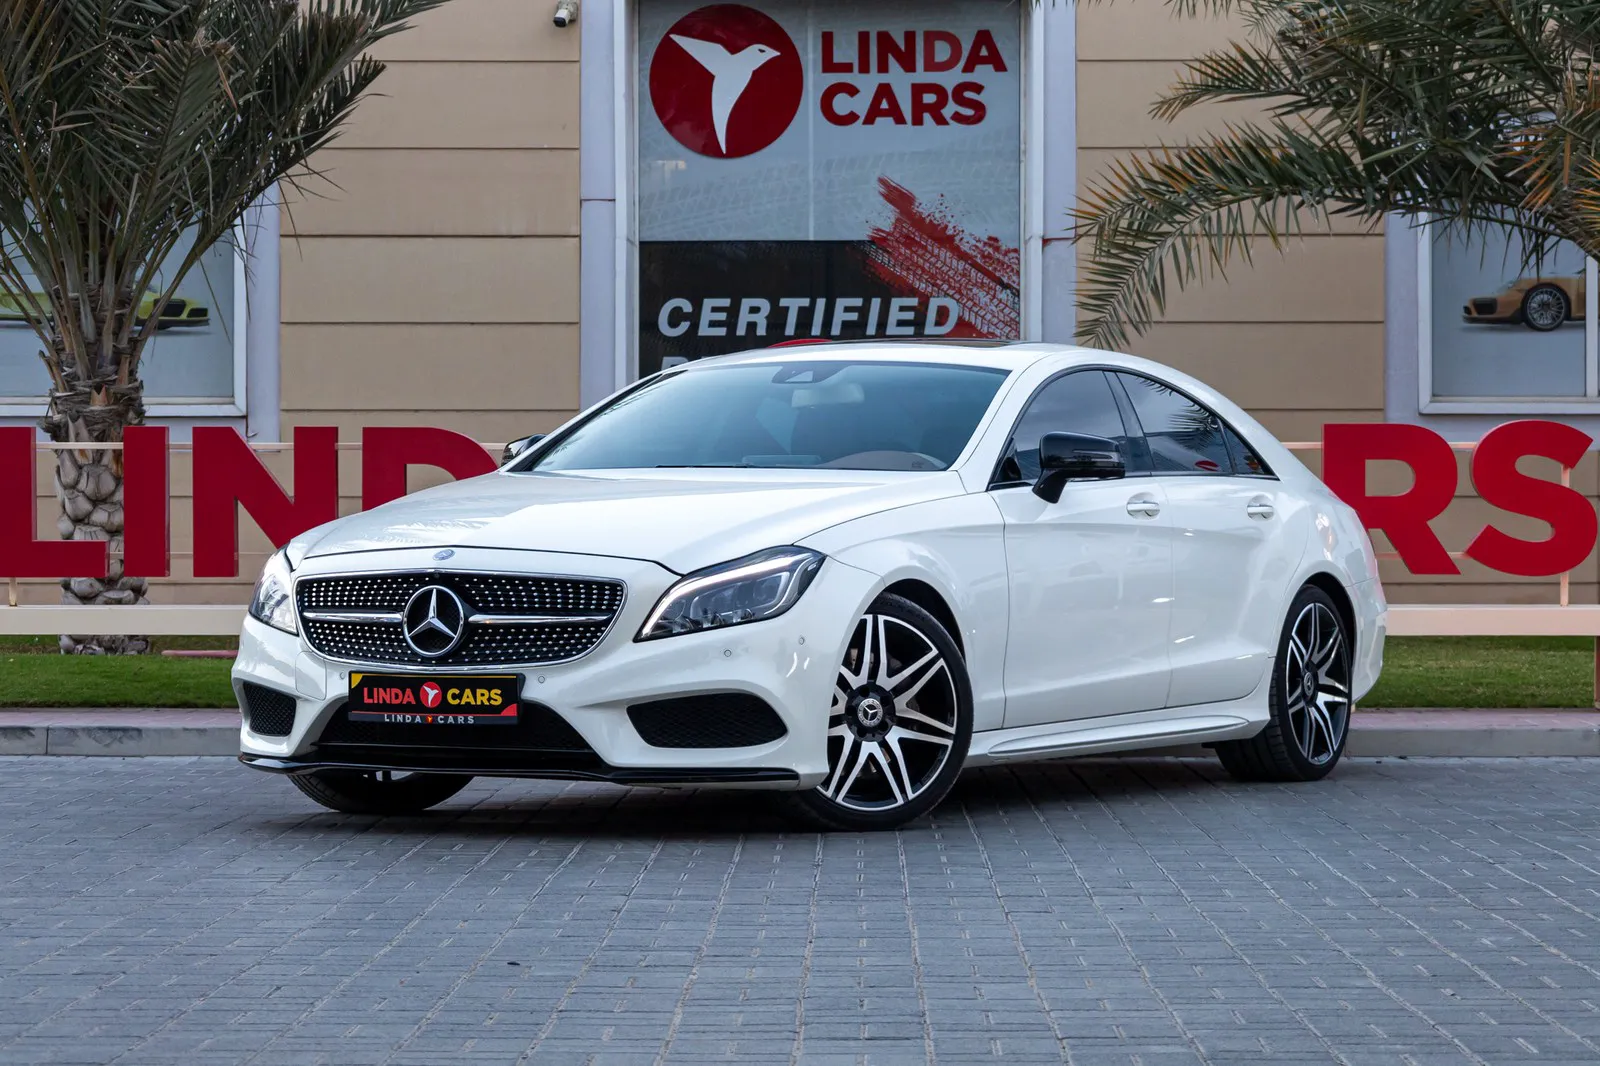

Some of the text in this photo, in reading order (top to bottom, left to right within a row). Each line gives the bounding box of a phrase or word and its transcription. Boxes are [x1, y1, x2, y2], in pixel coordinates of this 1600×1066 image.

[821, 30, 1007, 74] LINDA
[820, 82, 987, 126] CARS
[658, 298, 960, 337] CERTIFIED
[363, 687, 503, 706] LINDA CARS
[384, 713, 475, 724] LINDA CARS
